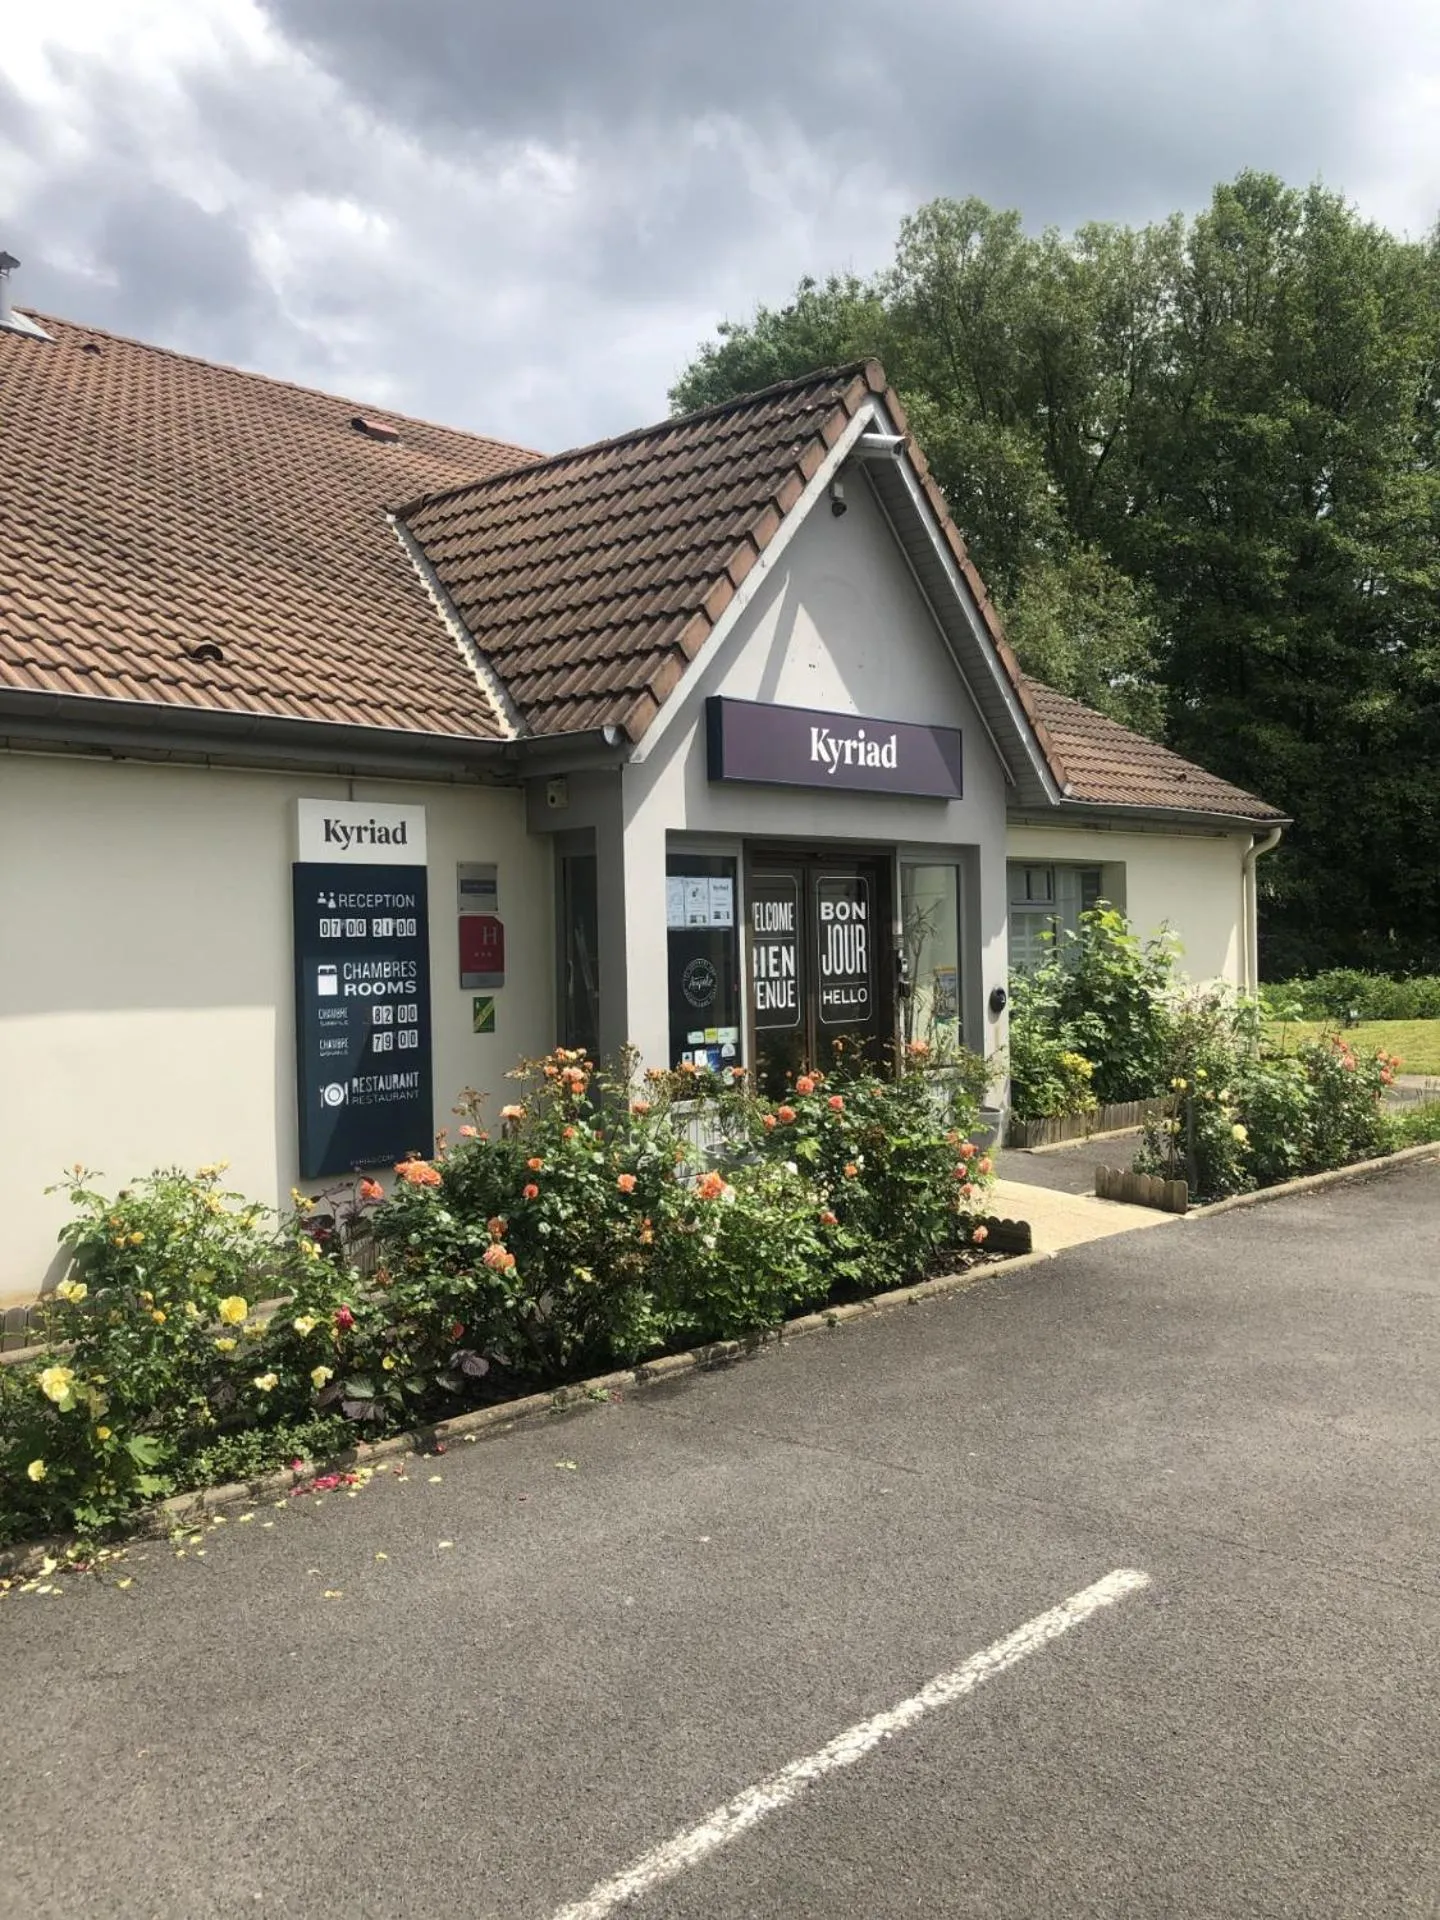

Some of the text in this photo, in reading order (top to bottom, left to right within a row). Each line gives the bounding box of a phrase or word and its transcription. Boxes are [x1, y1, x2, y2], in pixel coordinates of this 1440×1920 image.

[810, 726, 898, 774] Kyriad
[323, 818, 408, 851] Kyriad
[338, 893, 415, 908] RECEPTION
[820, 901, 866, 920] BON
[822, 924, 867, 975] JOUR
[343, 961, 417, 980] CHAMBRES
[344, 980, 417, 996] ROOMS
[823, 988, 868, 1005] HELLO
[352, 1072, 419, 1094] RESTAURANT
[351, 1089, 419, 1105] RESTAURANT
